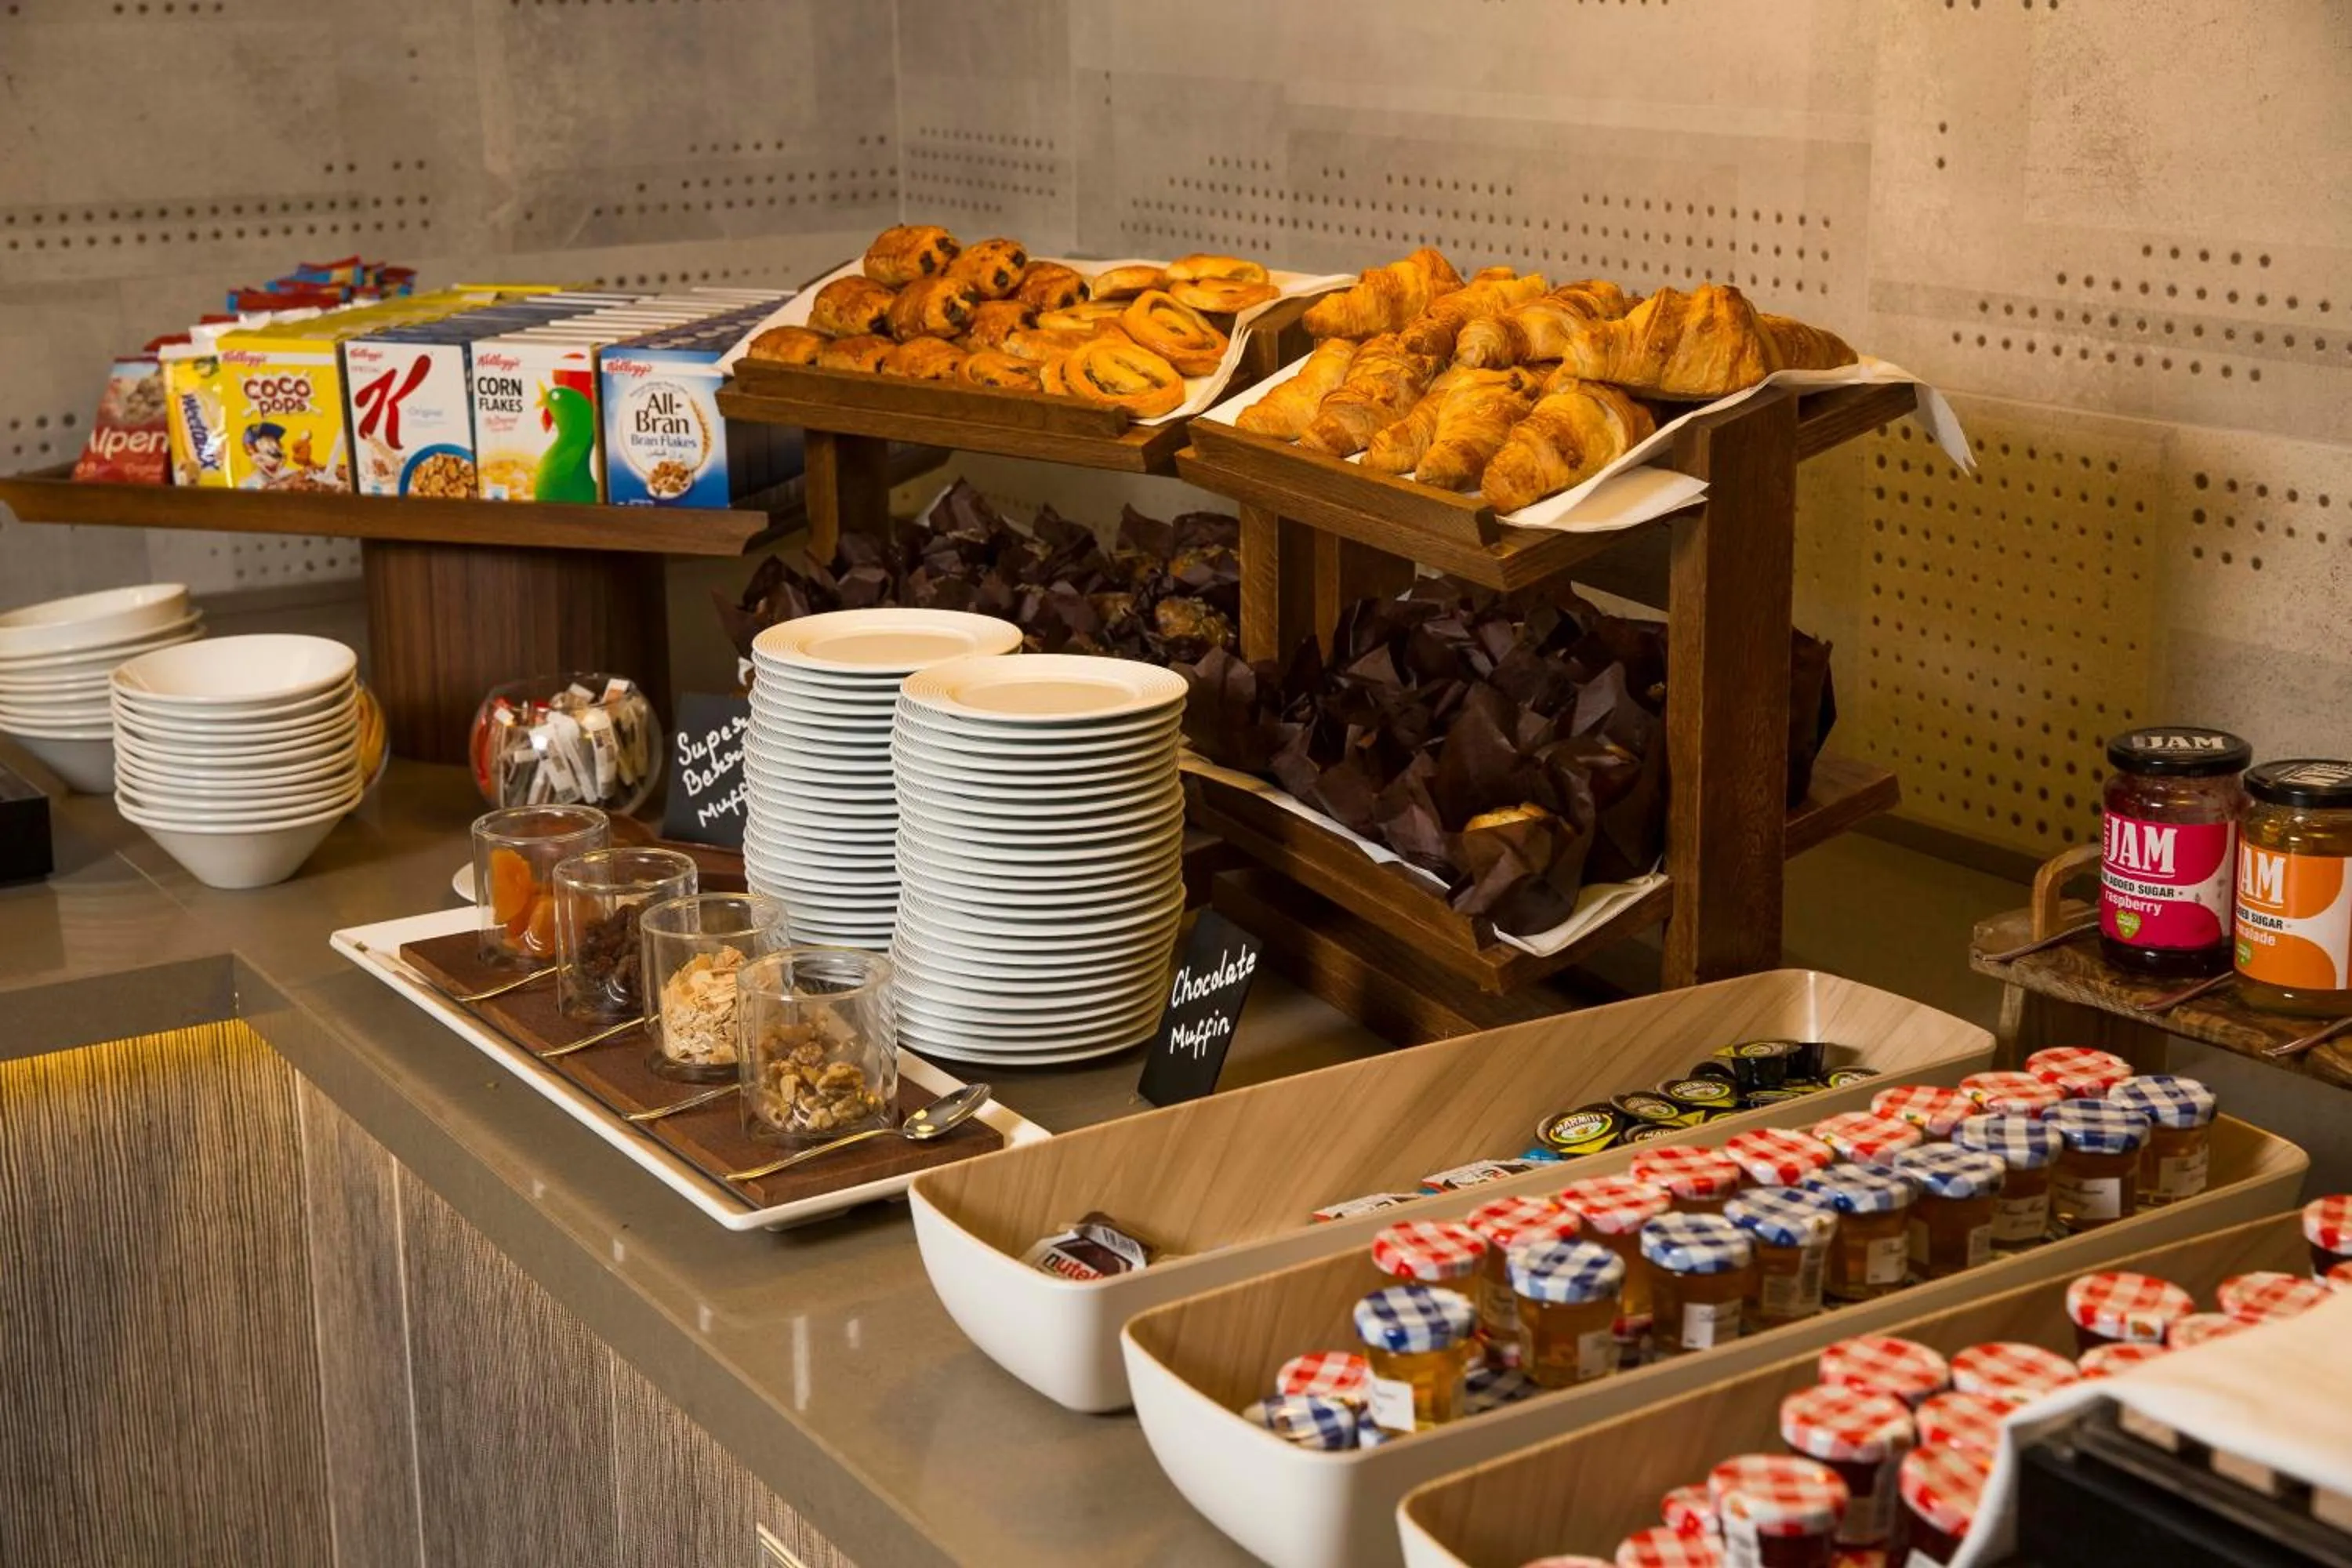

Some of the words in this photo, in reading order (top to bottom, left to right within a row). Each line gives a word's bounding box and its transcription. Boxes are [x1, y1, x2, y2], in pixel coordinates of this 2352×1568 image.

[244, 377, 310, 400] COCO
[477, 377, 523, 396] CORN
[260, 397, 307, 419] pops
[354, 354, 431, 450] K
[479, 397, 524, 414] FLAKES
[647, 392, 684, 415] All-
[636, 410, 690, 434] Bran
[630, 434, 659, 447] Bran
[660, 434, 698, 448] Flakes
[2147, 735, 2225, 750] JAM
[698, 782, 748, 828] Muff
[2108, 816, 2178, 874] JAM
[2109, 875, 2135, 892] ADDED
[2137, 883, 2175, 898] SUGAR
[2240, 845, 2286, 905] AM
[2104, 890, 2163, 916] raspberry
[2252, 911, 2284, 931] SUGAR
[1171, 943, 1257, 1009] Chocolate
[1169, 1009, 1230, 1060] Muffin
